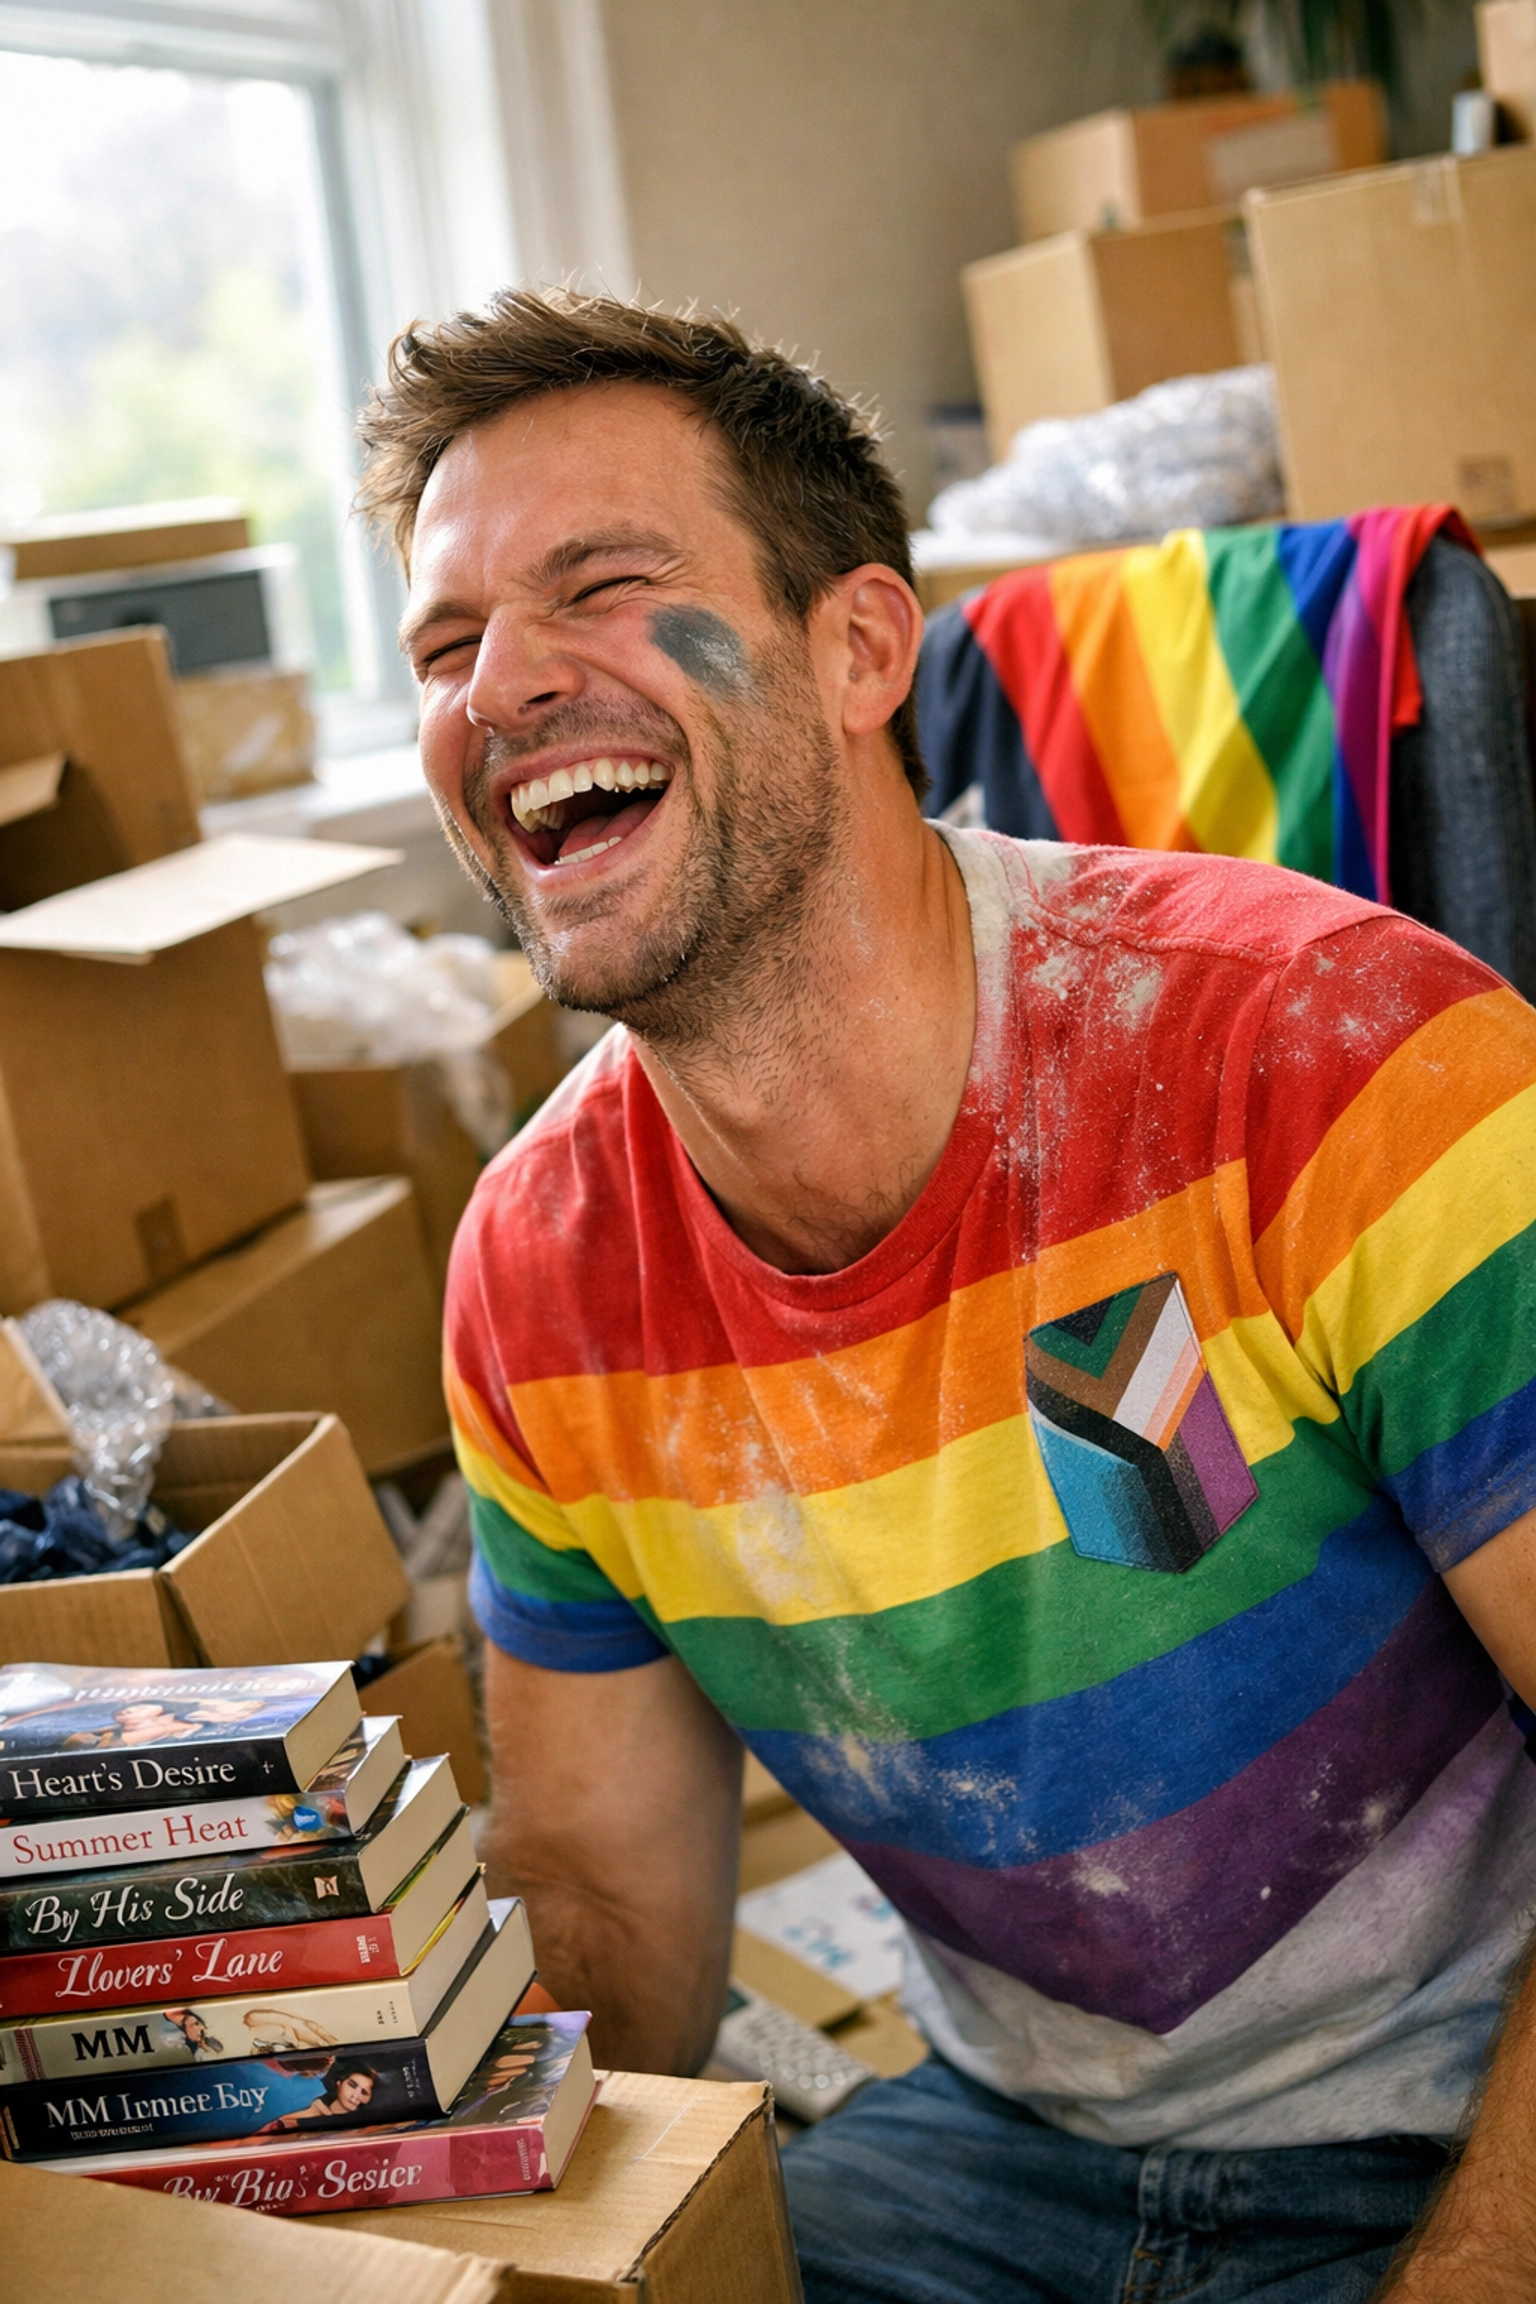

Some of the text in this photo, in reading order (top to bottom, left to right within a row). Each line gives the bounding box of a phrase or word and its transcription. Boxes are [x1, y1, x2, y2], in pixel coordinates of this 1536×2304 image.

[8, 1756, 237, 1799] Heart's Desire
[12, 1814, 249, 1865] Summer Heat
[25, 1873, 244, 1943] By His Side
[192, 1938, 283, 1983] Lane
[71, 2024, 155, 2061] MM
[43, 2096, 111, 2128] MM
